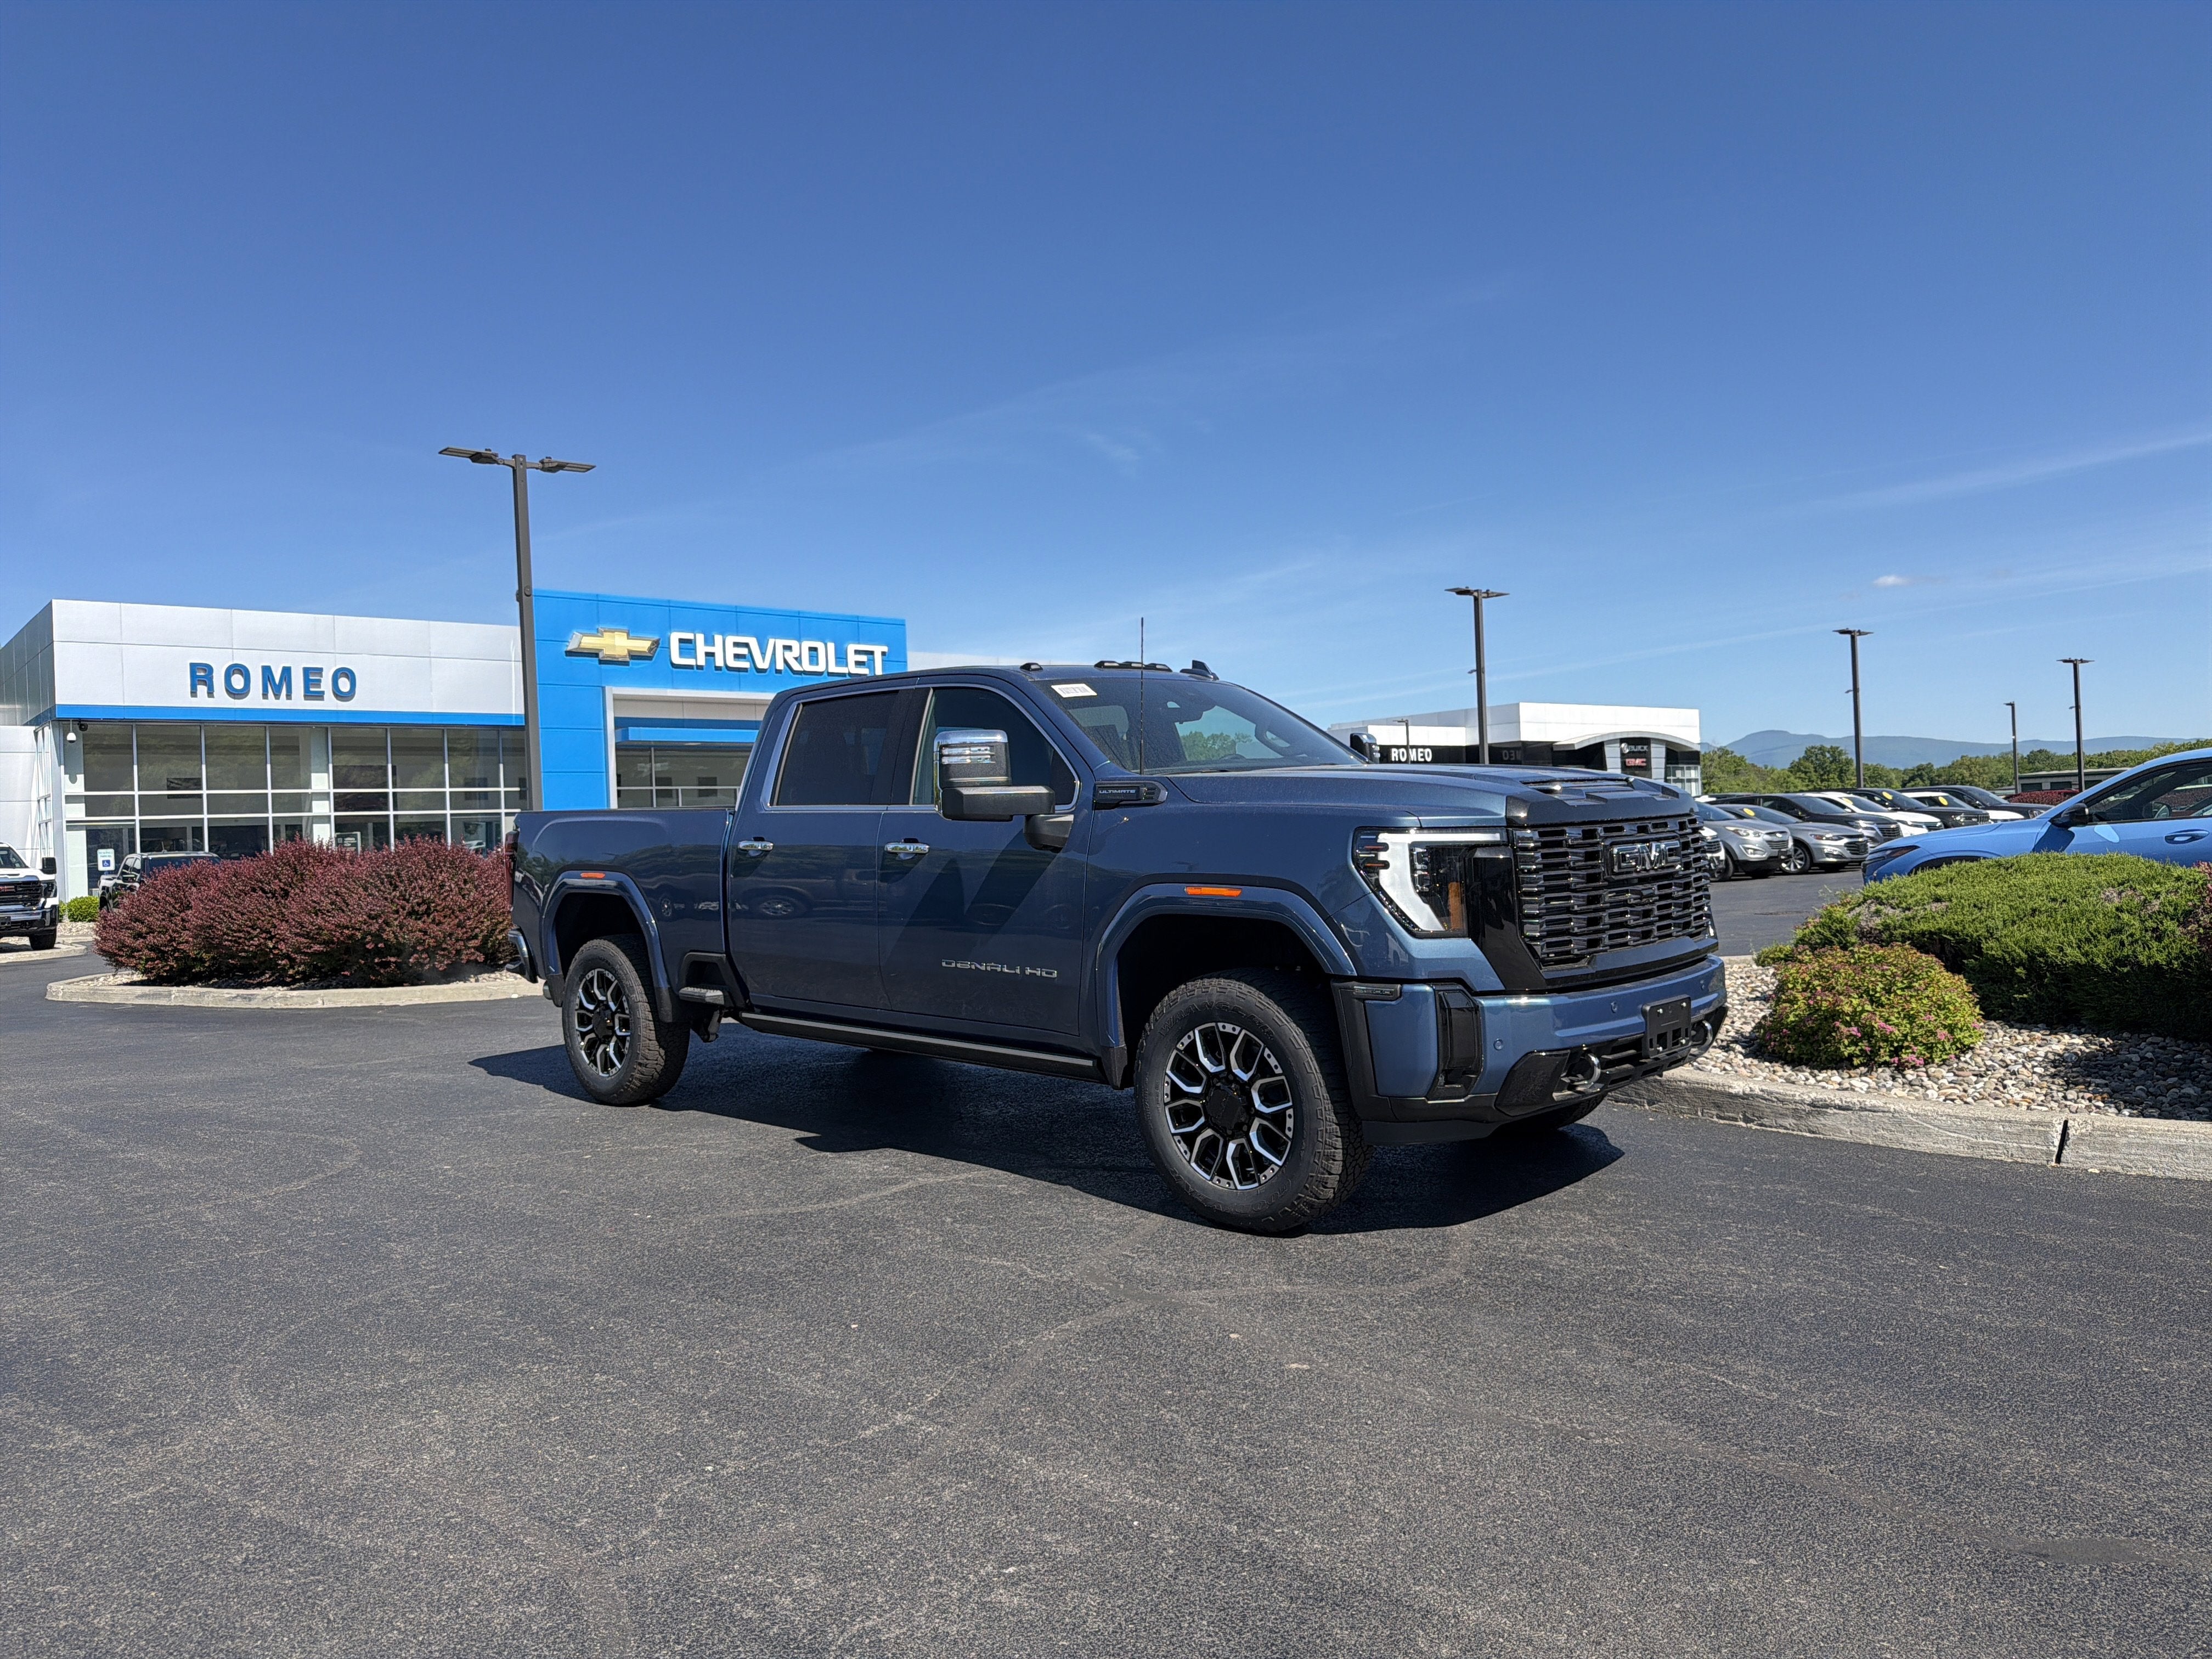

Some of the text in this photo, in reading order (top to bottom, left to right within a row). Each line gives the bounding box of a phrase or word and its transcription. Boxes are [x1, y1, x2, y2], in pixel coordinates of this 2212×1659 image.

[670, 631, 888, 675] CHEVROLET
[189, 662, 357, 697] ROMEO
[1391, 748, 1432, 761] ROMEO
[1626, 758, 1646, 766] GMC
[1613, 840, 1681, 872] GMC
[941, 959, 1057, 978] DENALI HD
